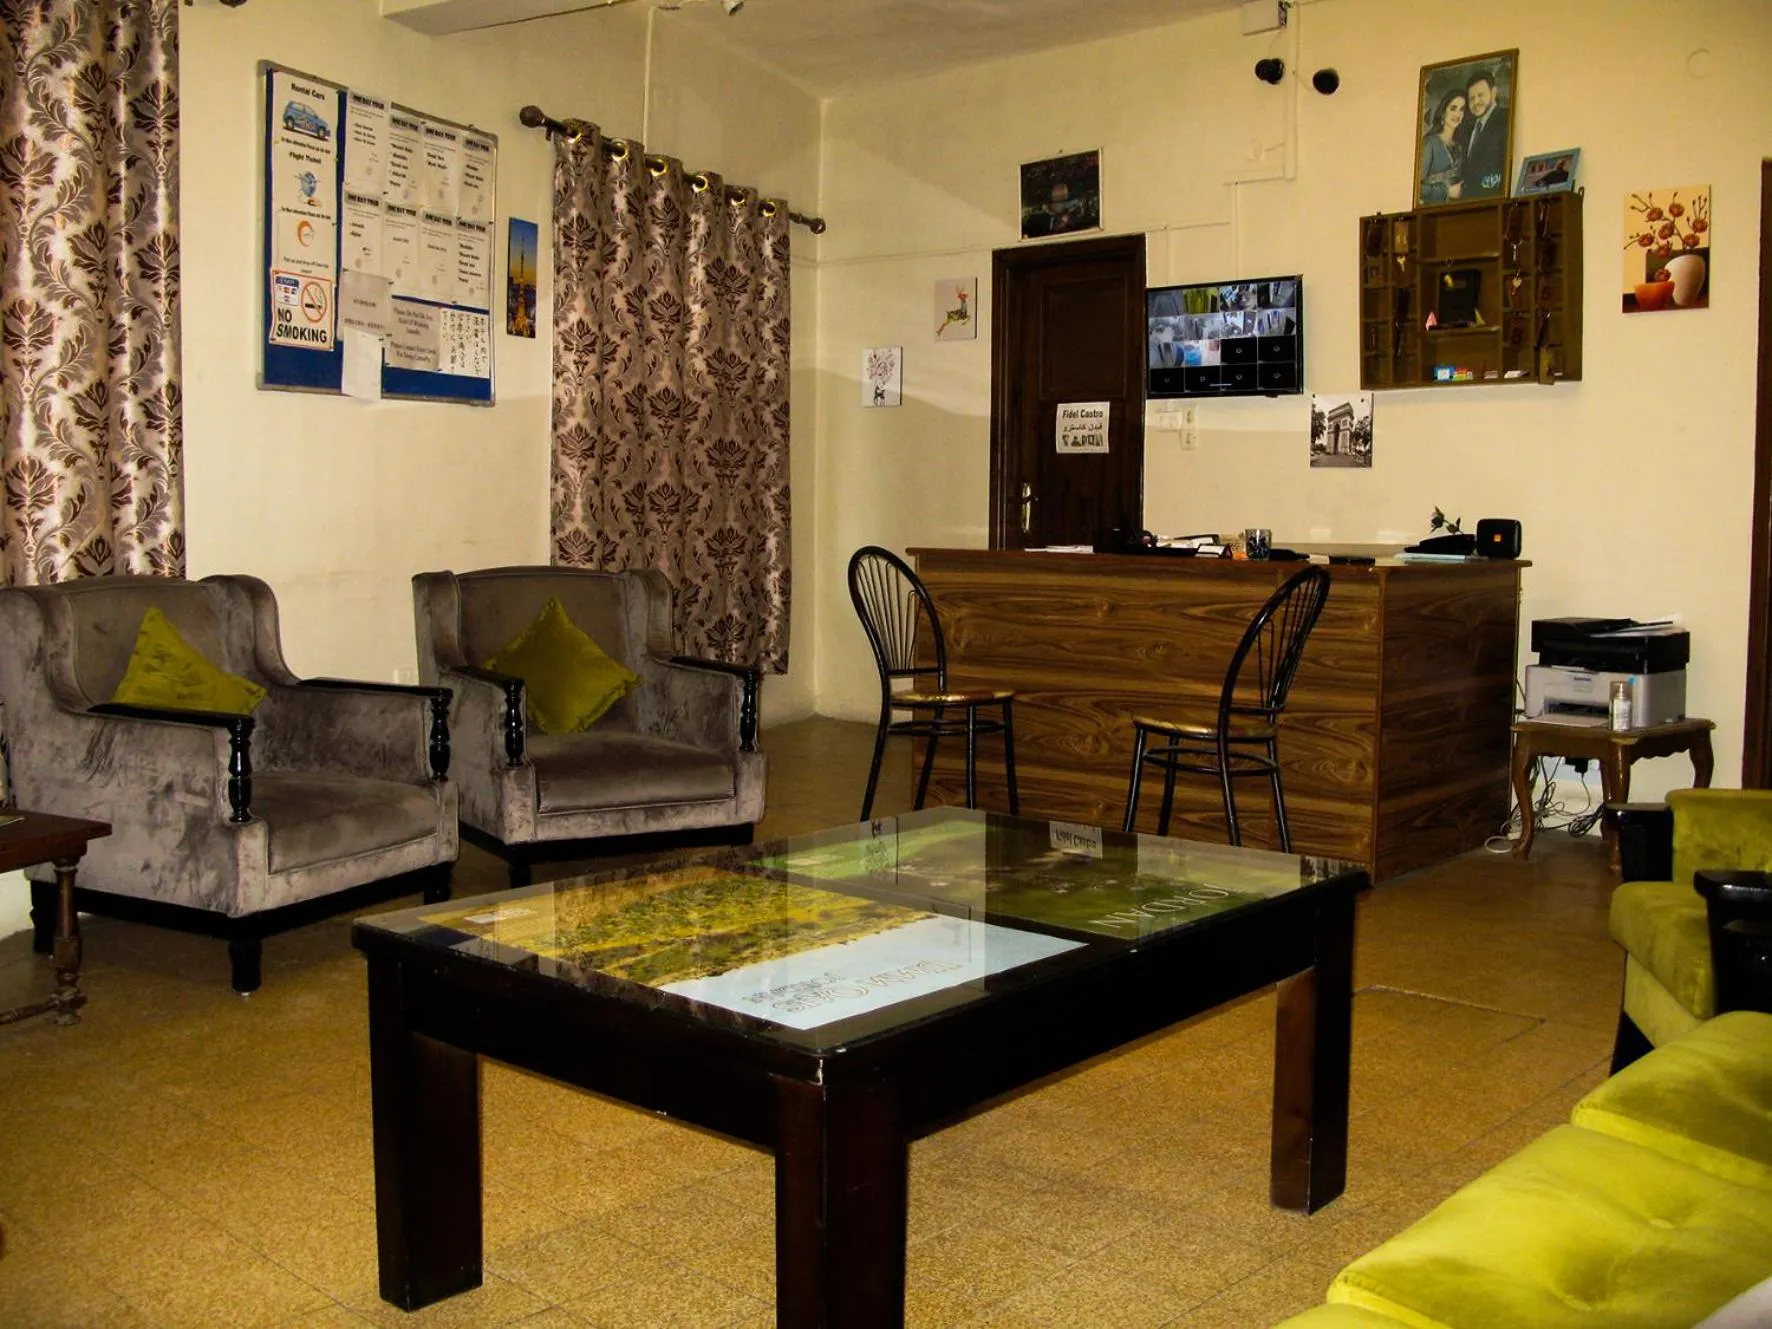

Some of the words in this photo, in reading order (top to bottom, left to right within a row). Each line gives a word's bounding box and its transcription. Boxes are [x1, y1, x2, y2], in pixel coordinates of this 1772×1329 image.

[311, 89, 326, 101] Cars
[277, 307, 293, 324] NO
[276, 323, 328, 344] SMOKING
[1062, 409, 1079, 419] Fidel
[1080, 409, 1103, 419] Castro
[1089, 882, 1238, 929] JORDAN
